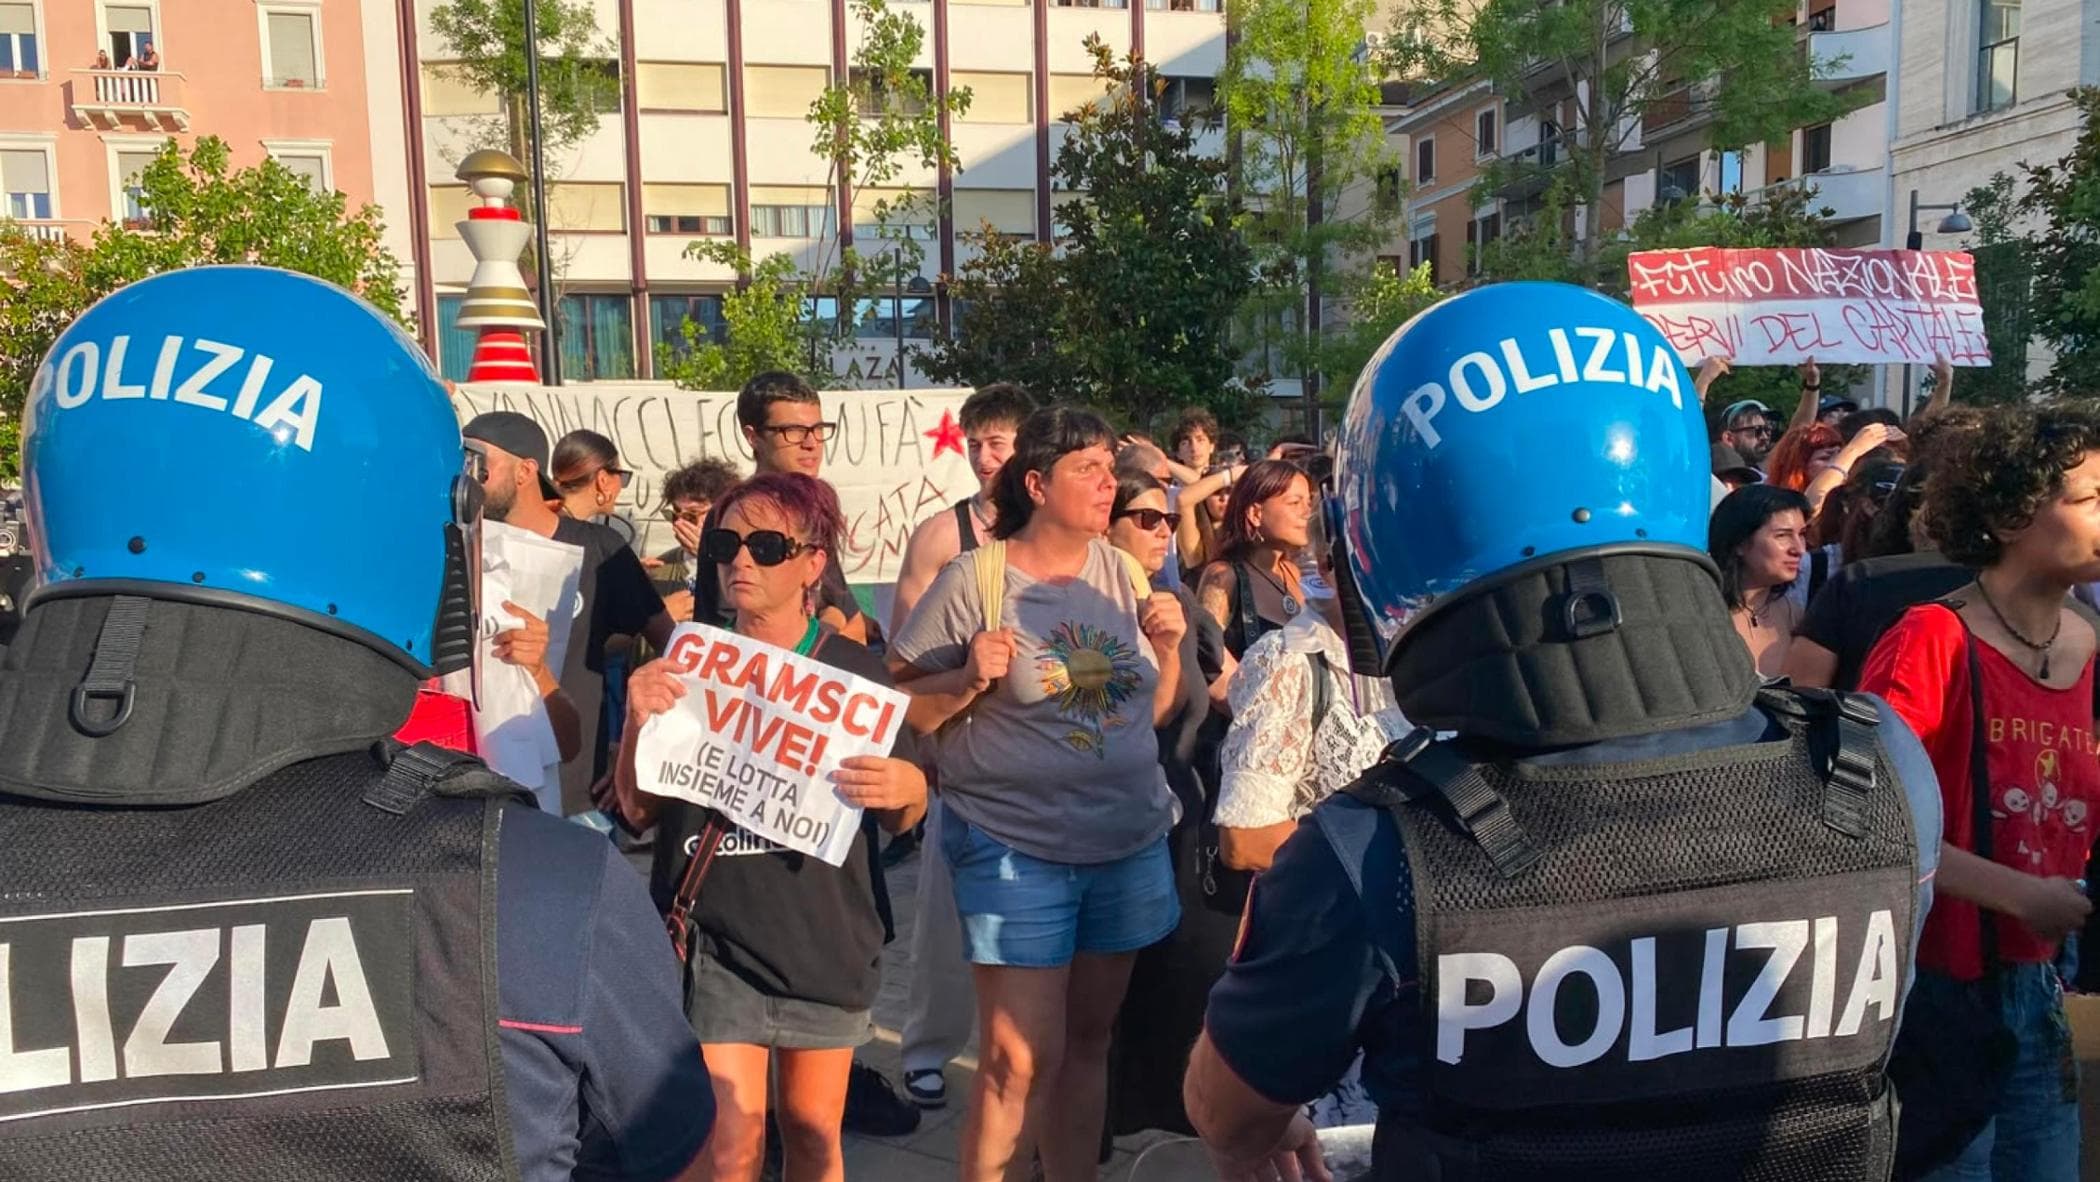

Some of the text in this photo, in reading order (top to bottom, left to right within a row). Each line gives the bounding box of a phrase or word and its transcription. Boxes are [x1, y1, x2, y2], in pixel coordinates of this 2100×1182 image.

[1776, 247, 1977, 302] NAZIONALE
[828, 356, 901, 381] LAZA
[1750, 312, 1843, 354] DEL
[1842, 299, 1992, 365] CAPITALE
[1401, 326, 1684, 450] POLIZIA
[667, 632, 896, 745] GRAMSCI
[704, 688, 830, 777] VIVE!
[657, 760, 831, 847] INSIEME A NOI)
[696, 741, 799, 808] (E LOTTA
[0, 916, 392, 1094] LIZIA
[1436, 909, 1898, 1069] POLIZIA
